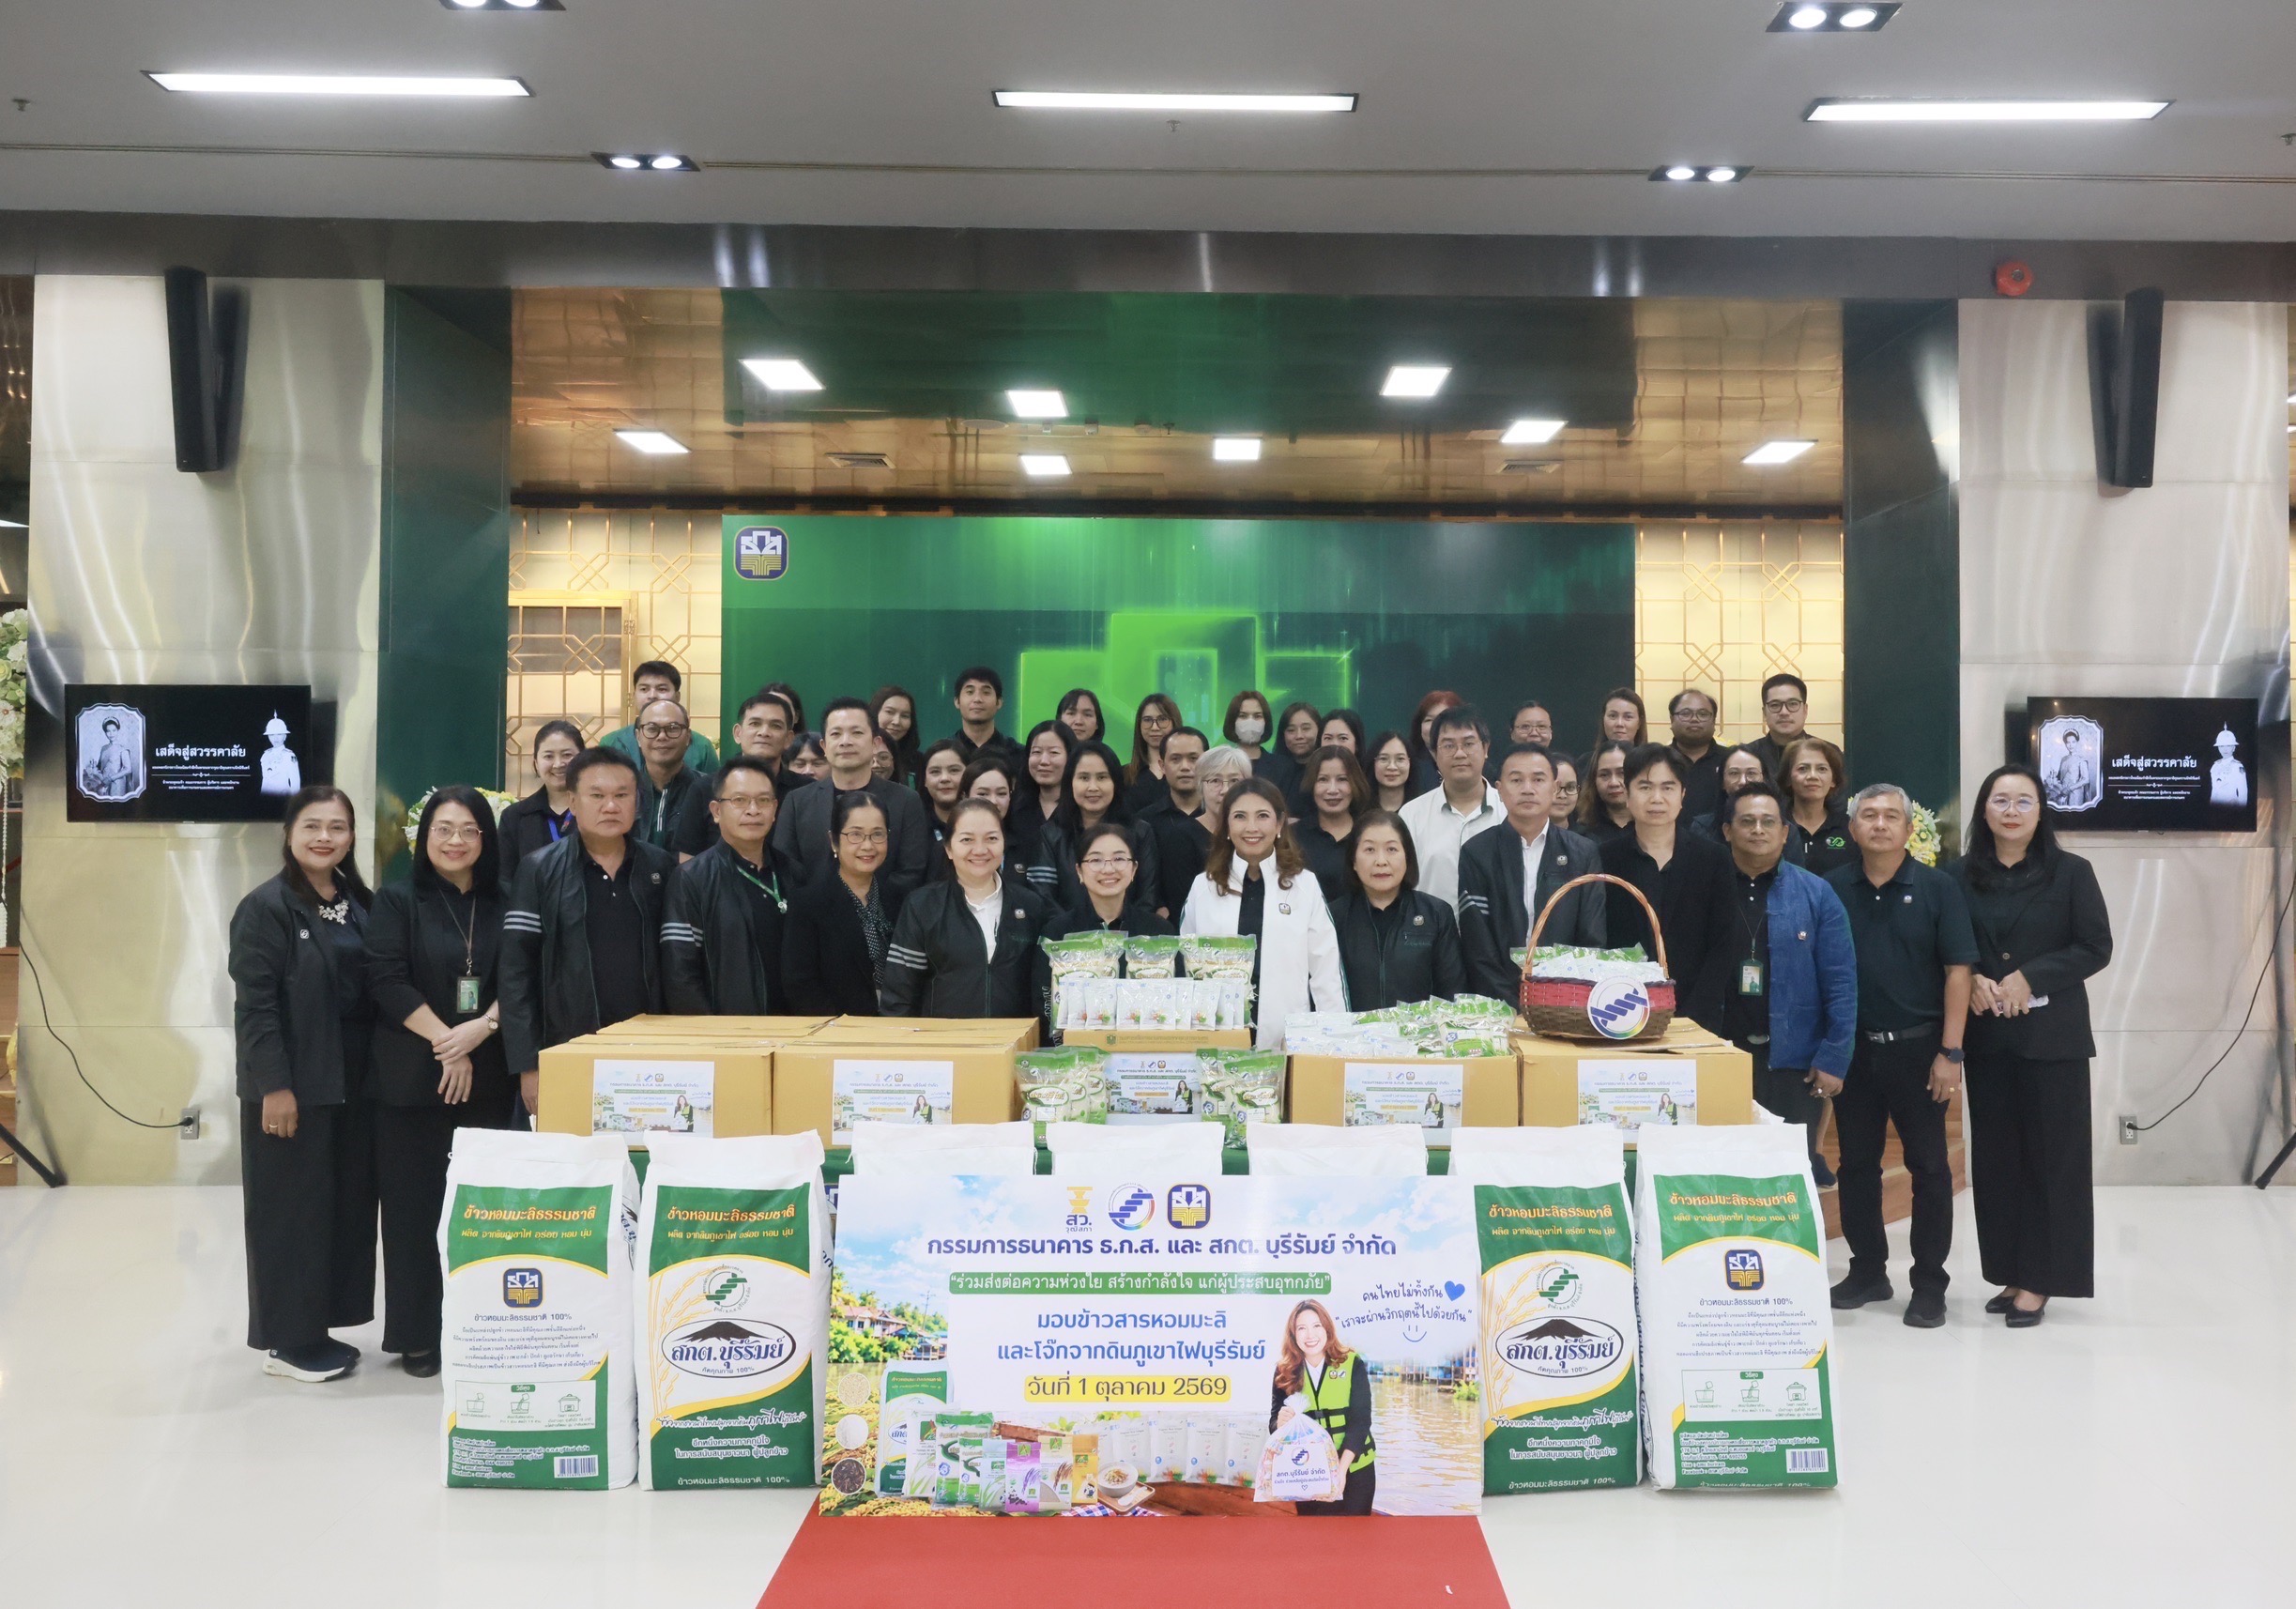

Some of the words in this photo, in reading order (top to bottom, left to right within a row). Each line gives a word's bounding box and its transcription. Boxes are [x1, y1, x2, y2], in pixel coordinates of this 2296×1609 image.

[155, 743, 246, 761] เสด็จสู่สวรรคาลัย
[2111, 754, 2197, 772] เสด็จสู่สวรรคาลัย
[1669, 1191, 1798, 1207] ข้าวหอมมะลิธรรมชาติ
[464, 1204, 597, 1220] ข้าวหอมมะลิธรรมชาติ
[667, 1203, 796, 1222] ข้าวหอมมะลิธรรมชาติ
[1489, 1203, 1614, 1219] ข้าวหอมมะลิธรรมชาติ
[1065, 1213, 1093, 1226] สว.
[1065, 1225, 1093, 1234] วุฒิสภา
[927, 1238, 1094, 1255] กรรมการธนาคาร
[1100, 1238, 1160, 1254] ธ.ก.ส.
[1168, 1238, 1202, 1254] และ
[1209, 1237, 1260, 1254] สกต.
[1266, 1233, 1337, 1259] บุรีรัมย์
[1342, 1234, 1397, 1256] จำกัด
[950, 1272, 1103, 1291] “ร่วมส่งต่อความห่วงใย
[1108, 1272, 1193, 1291] สร้างกำลังใจ
[1362, 1280, 1444, 1301] คนไทยไม่ทิ้งกัน
[1773, 1297, 1794, 1306] 100%
[474, 1312, 547, 1322] ข้าวหอมมะลิธรรมชาติ
[551, 1312, 573, 1321] 100%
[1037, 1309, 1227, 1329] มอบข้าวสารหอมมะลิ
[671, 1336, 786, 1369] สกต.บุรีรัมย์
[998, 1339, 1265, 1367] และโจ๊กจากดินภูเขาไฟบุรีรัมย์
[1506, 1334, 1615, 1369] สกต.บุรีรัมย์
[1028, 1371, 1070, 1396] วันที่
[1078, 1378, 1087, 1396] 1
[1095, 1377, 1166, 1402] ตุลาคม
[1173, 1377, 1228, 1396] 2569
[692, 1434, 770, 1448] อีกหนึ่งความภาคภูมิใจ
[1527, 1434, 1601, 1448] อีกหนึ่งความภาคภูมิใจ
[674, 1448, 750, 1460] ในการสนับสนุนชาวนา
[752, 1446, 788, 1459] ผู้ปลูกข้าว
[1509, 1448, 1583, 1461] ในการสนับสนุนชาวนา
[1584, 1447, 1617, 1460] ผู้ปลูกข้าว
[1310, 1467, 1325, 1476] จำกัด
[678, 1477, 761, 1486] ข้าวหอมมะลิธรรมชาติ
[1508, 1478, 1589, 1490] ข้าวหอมมะลิธรรมชาติ
